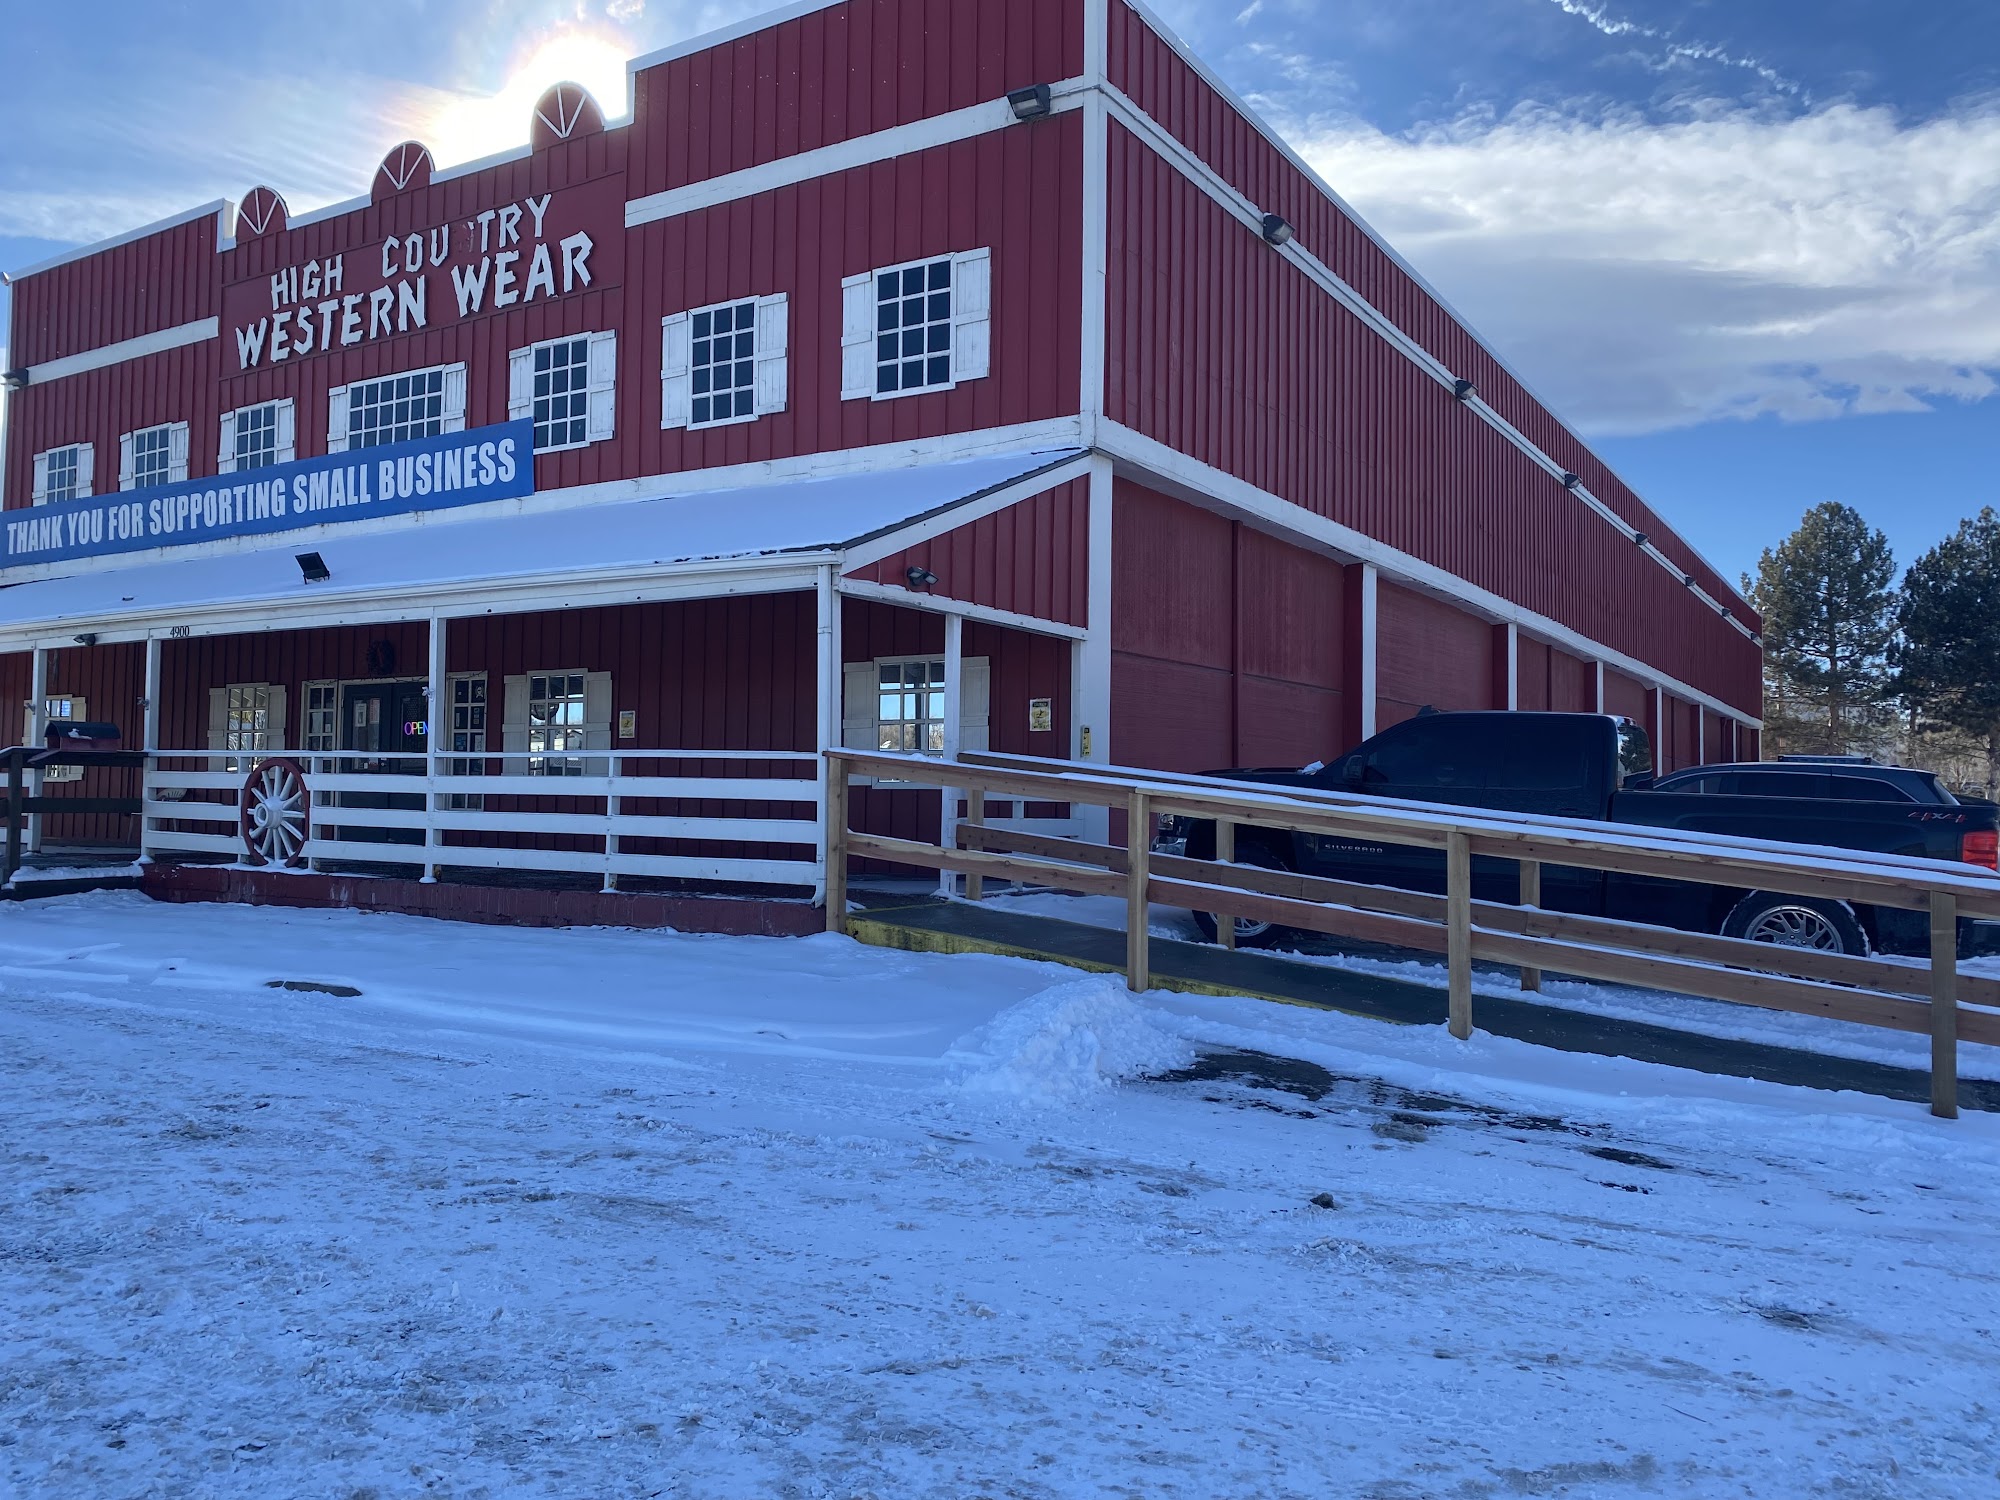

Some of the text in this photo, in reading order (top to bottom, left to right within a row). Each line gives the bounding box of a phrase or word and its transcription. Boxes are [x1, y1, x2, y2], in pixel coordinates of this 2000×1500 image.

[235, 230, 594, 370] WESTERN WEAR
[270, 193, 552, 310] HIGH COUTRY
[7, 438, 516, 555] THANK YOU FOR SUPPORTING SMALL BUSINESS
[169, 625, 190, 639] 4900
[1324, 843, 1383, 853] SILVERADO
